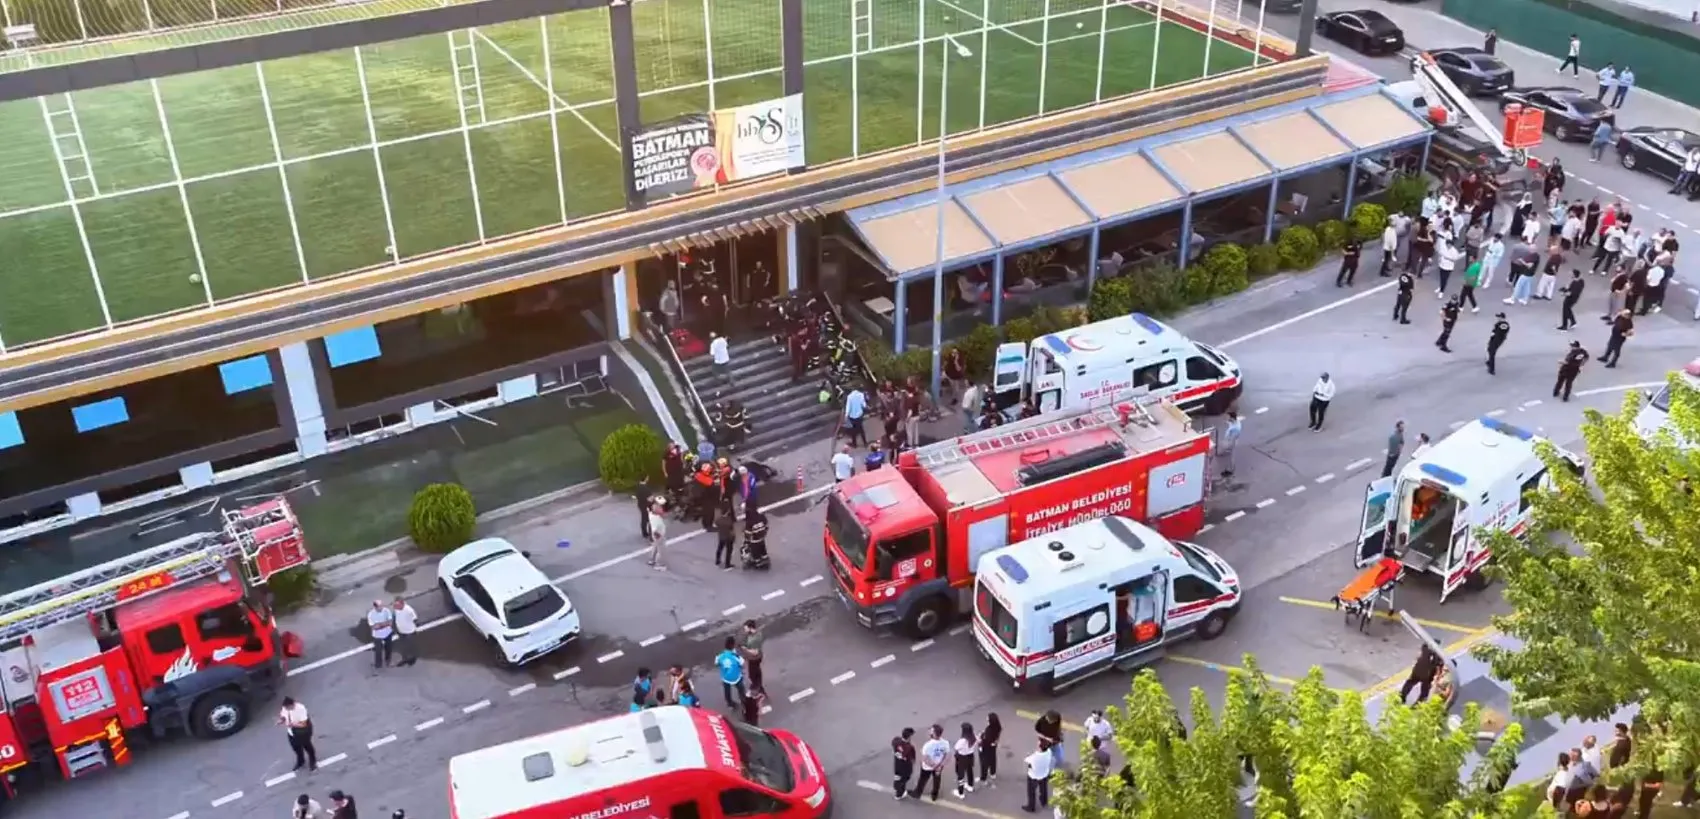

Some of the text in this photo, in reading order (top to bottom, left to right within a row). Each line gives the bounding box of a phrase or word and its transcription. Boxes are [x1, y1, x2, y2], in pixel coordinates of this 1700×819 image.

[632, 129, 709, 160] BATMAN
[1025, 480, 1132, 524] BATMAN BELEDİYESİ
[66, 679, 94, 697] 112
[581, 795, 650, 819] BELEDİYESİ
